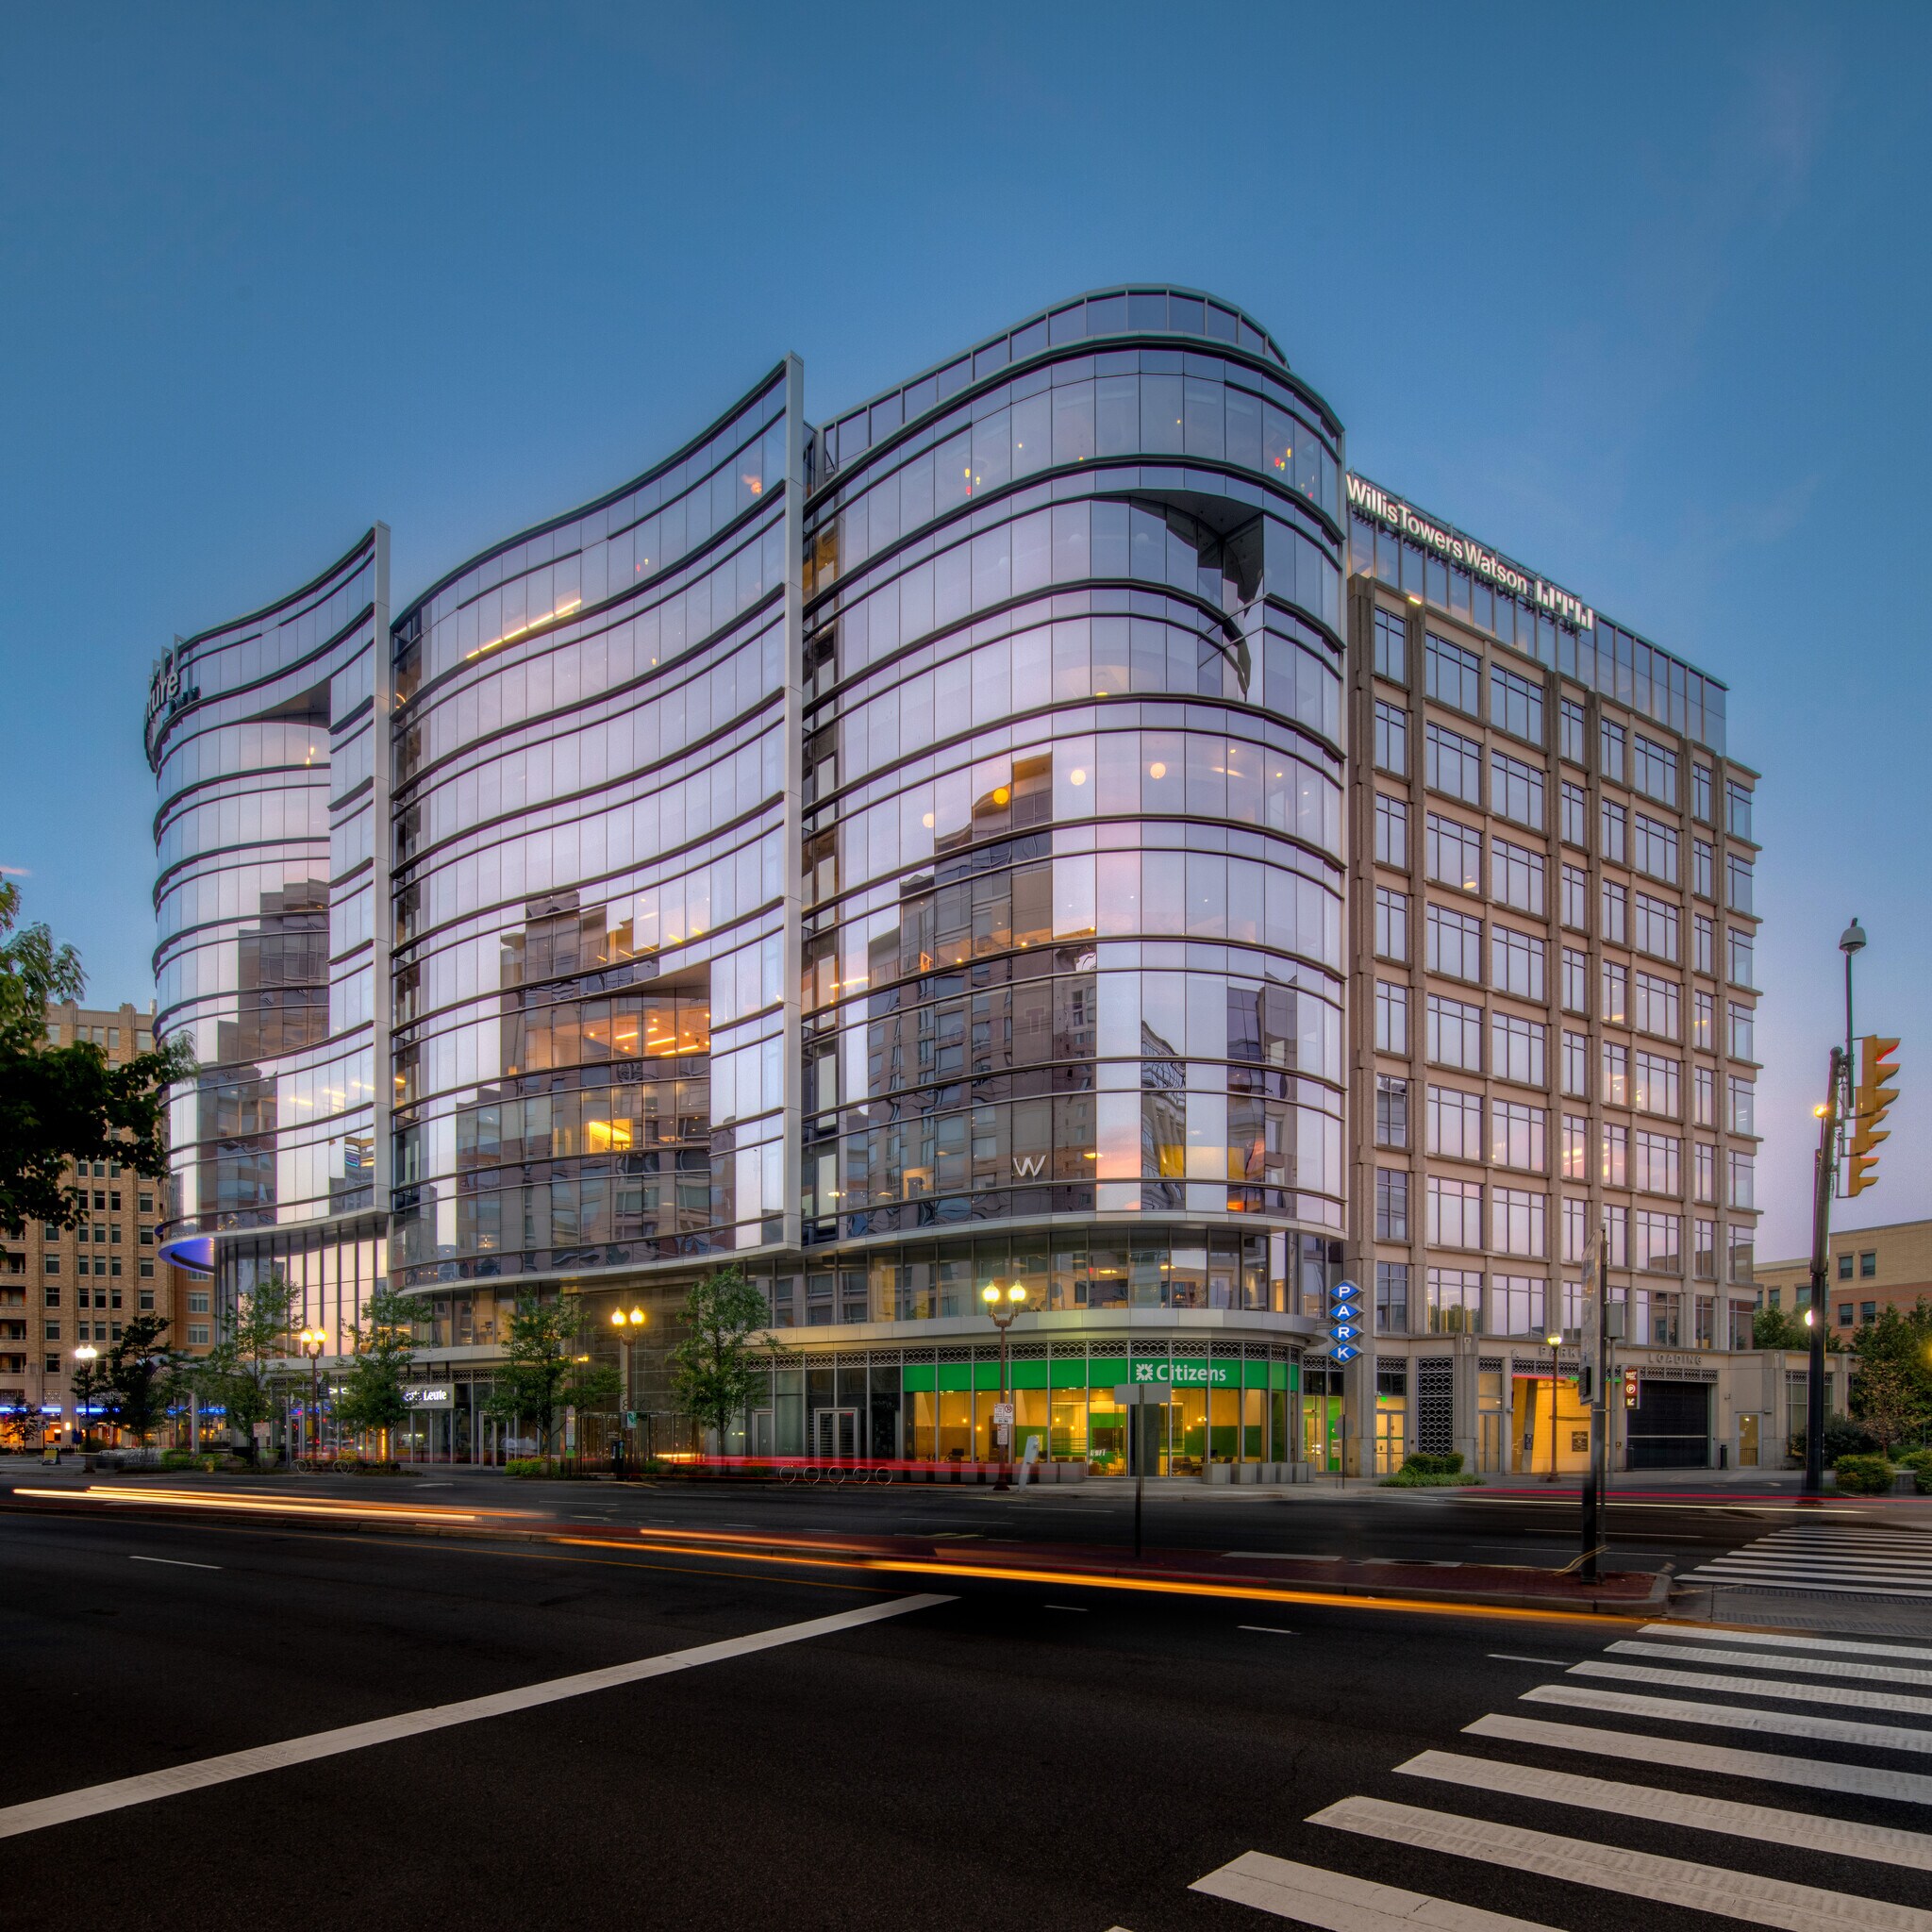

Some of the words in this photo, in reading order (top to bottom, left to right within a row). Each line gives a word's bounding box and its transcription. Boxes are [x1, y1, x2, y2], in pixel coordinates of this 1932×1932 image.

[1337, 1286, 1351, 1359] PARK
[1648, 1353, 1702, 1366] LOADING
[1156, 1364, 1226, 1382] Citizens
